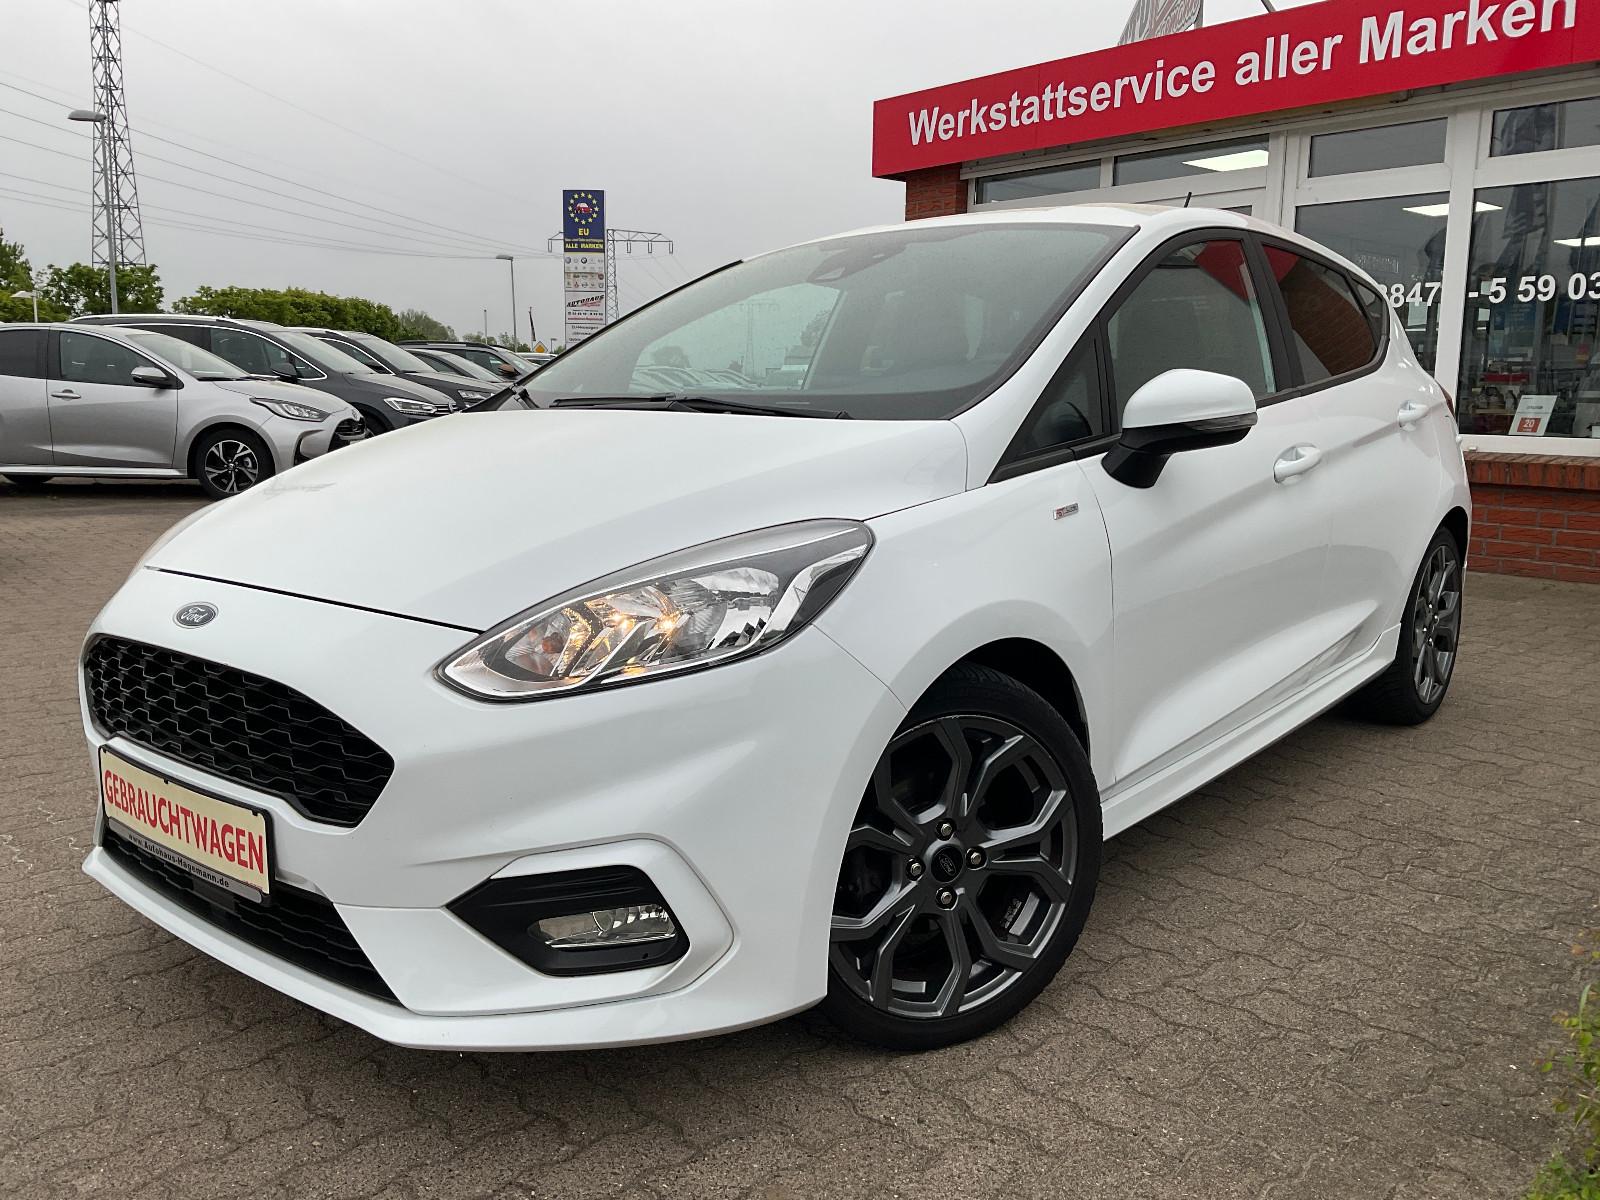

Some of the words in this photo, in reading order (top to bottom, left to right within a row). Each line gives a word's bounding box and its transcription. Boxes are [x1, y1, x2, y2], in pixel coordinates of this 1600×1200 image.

[908, 59, 1216, 146] Werkstattservice
[1235, 33, 1344, 86] aller
[1359, 0, 1577, 64] Marken
[578, 228, 590, 236] EU
[1517, 274, 1556, 302] 59
[181, 607, 208, 622] Ford
[104, 769, 264, 874] GEBRAUCHTWAGEN
